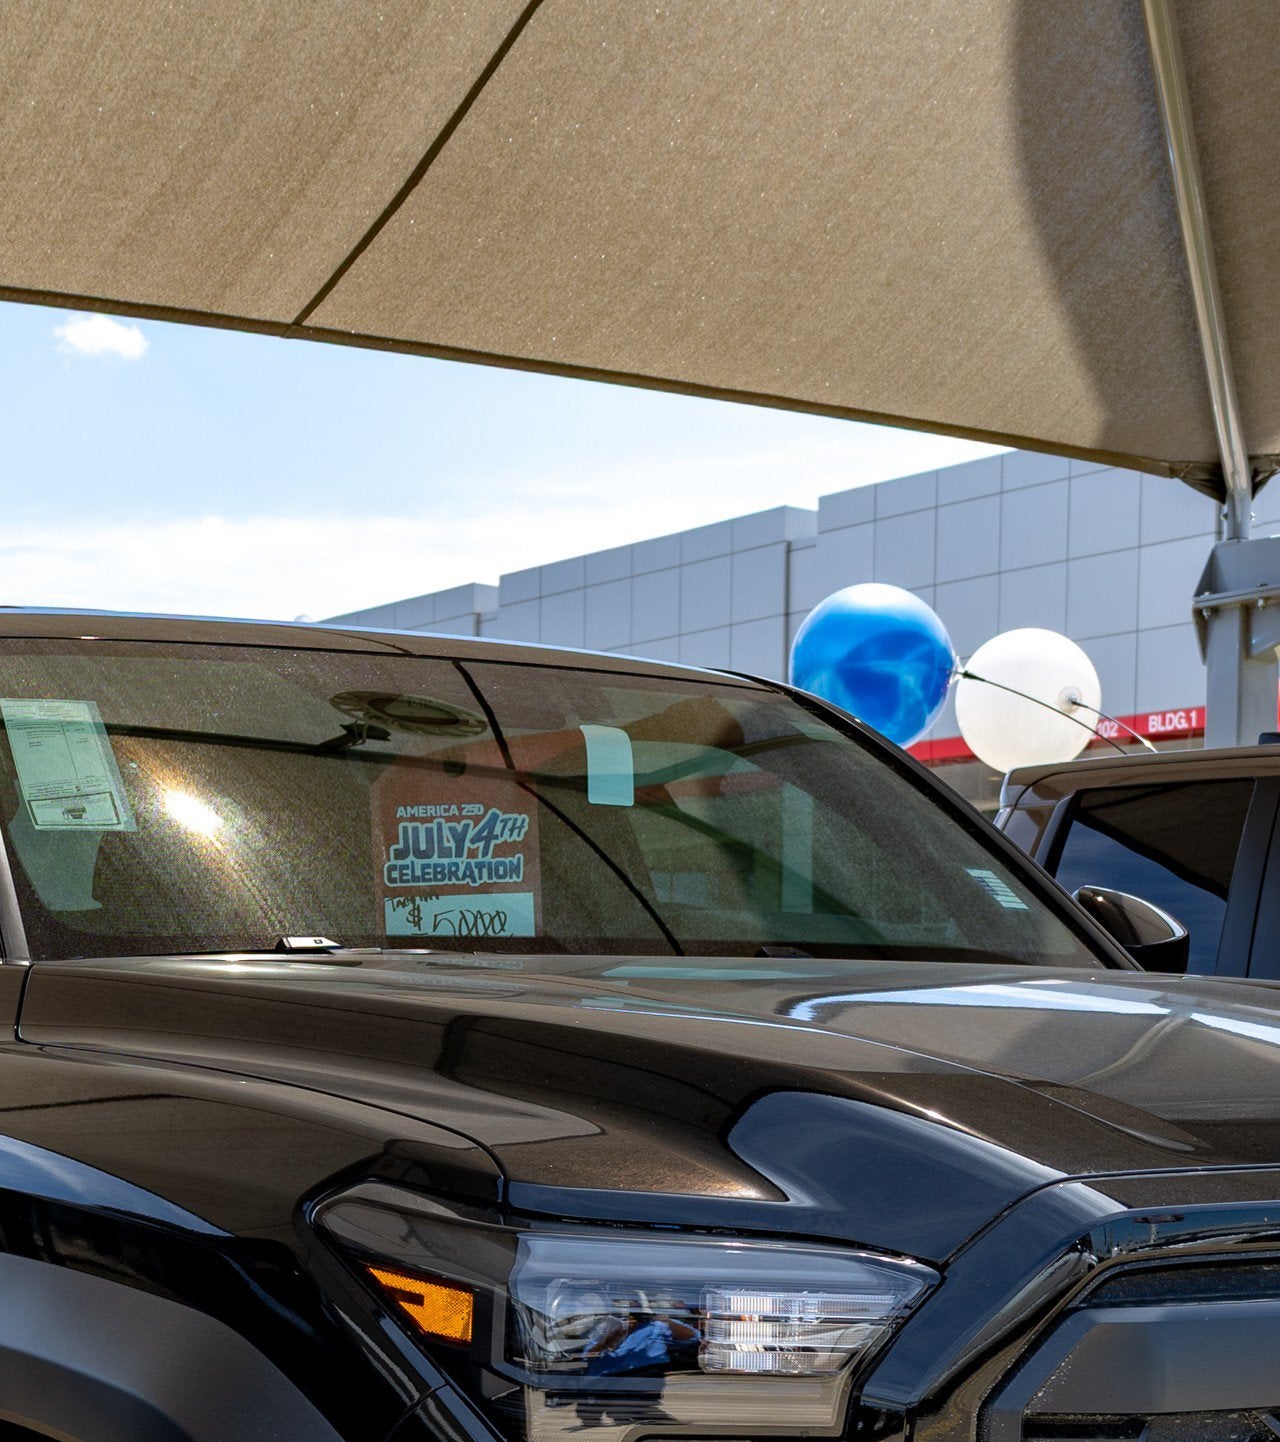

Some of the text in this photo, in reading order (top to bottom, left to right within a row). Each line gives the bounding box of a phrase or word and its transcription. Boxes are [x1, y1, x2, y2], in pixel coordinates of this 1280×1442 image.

[396, 805, 459, 818] AMERICA
[391, 820, 472, 860] JULY
[385, 855, 523, 885] CELEBRATION
